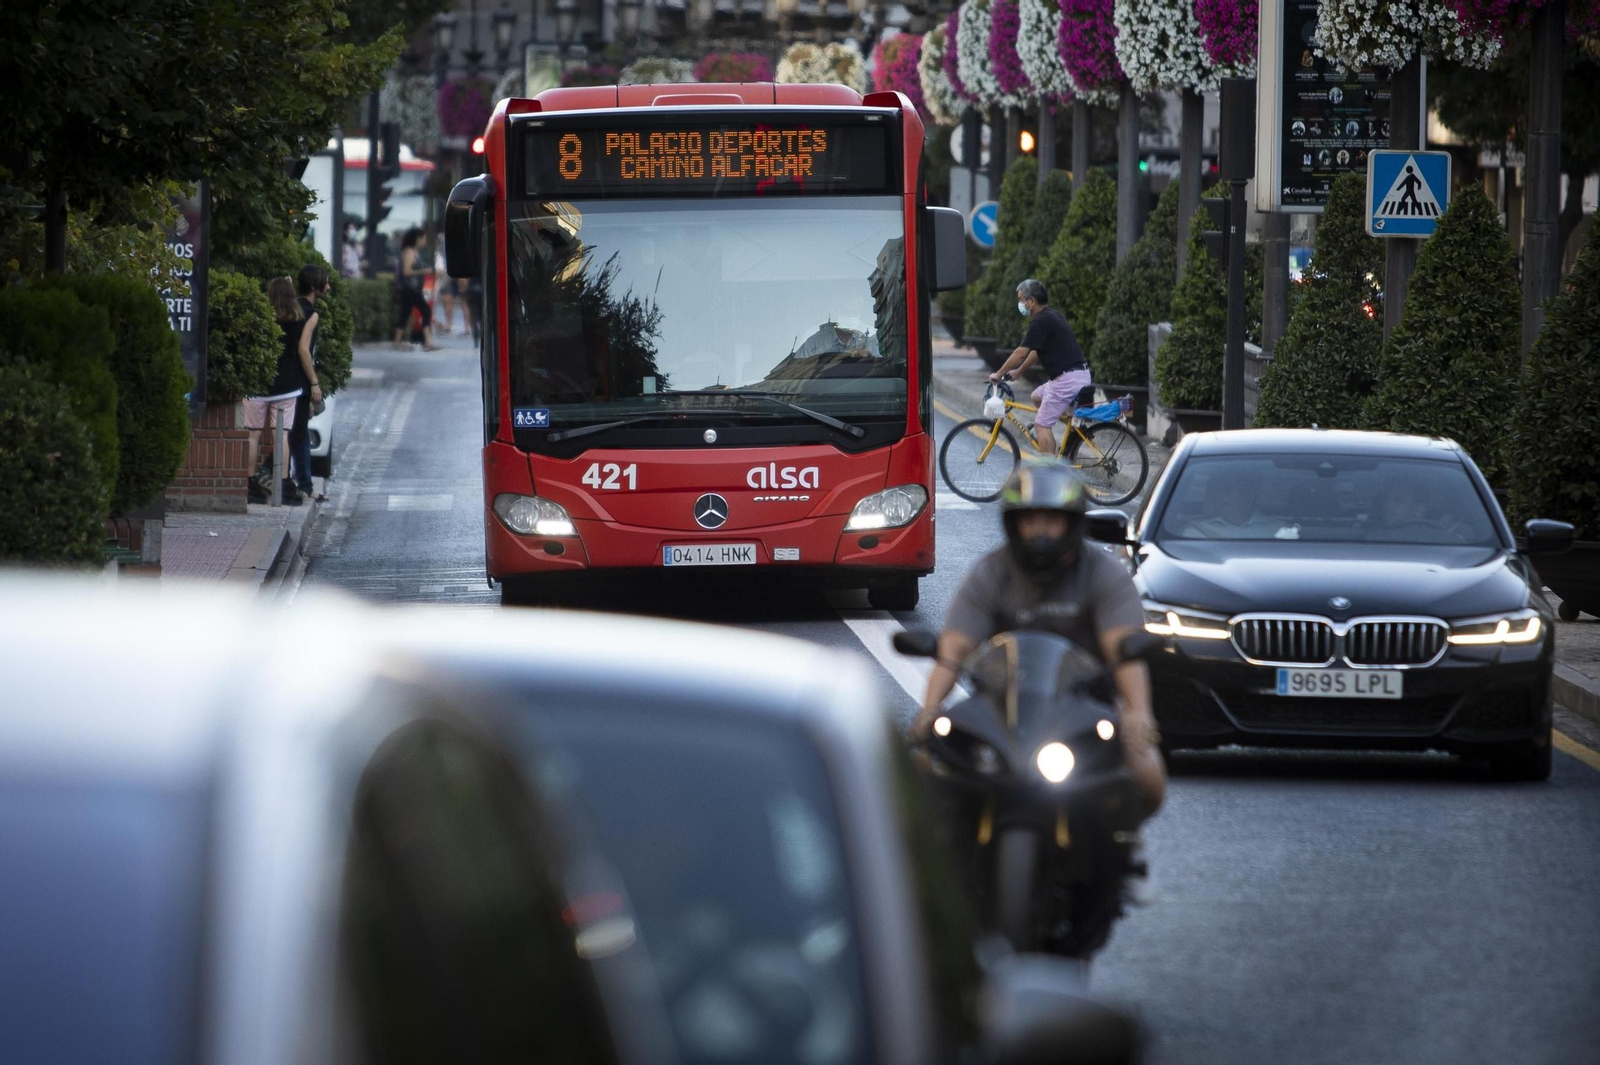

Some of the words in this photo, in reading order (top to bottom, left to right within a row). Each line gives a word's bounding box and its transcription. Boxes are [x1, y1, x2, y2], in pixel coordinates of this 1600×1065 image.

[605, 132, 702, 155] PALACIO
[709, 129, 827, 154] DEPORTES
[559, 133, 583, 180] 8
[620, 155, 704, 180] CAMINO
[711, 154, 813, 178] ALFACAR
[166, 298, 192, 313] RTE
[178, 316, 191, 331] TI
[581, 463, 637, 490] 421
[746, 461, 819, 489] alsa
[673, 547, 714, 563] 0414
[721, 546, 752, 562] HNK
[1291, 672, 1347, 694] 9695
[1354, 673, 1396, 695] LPL
